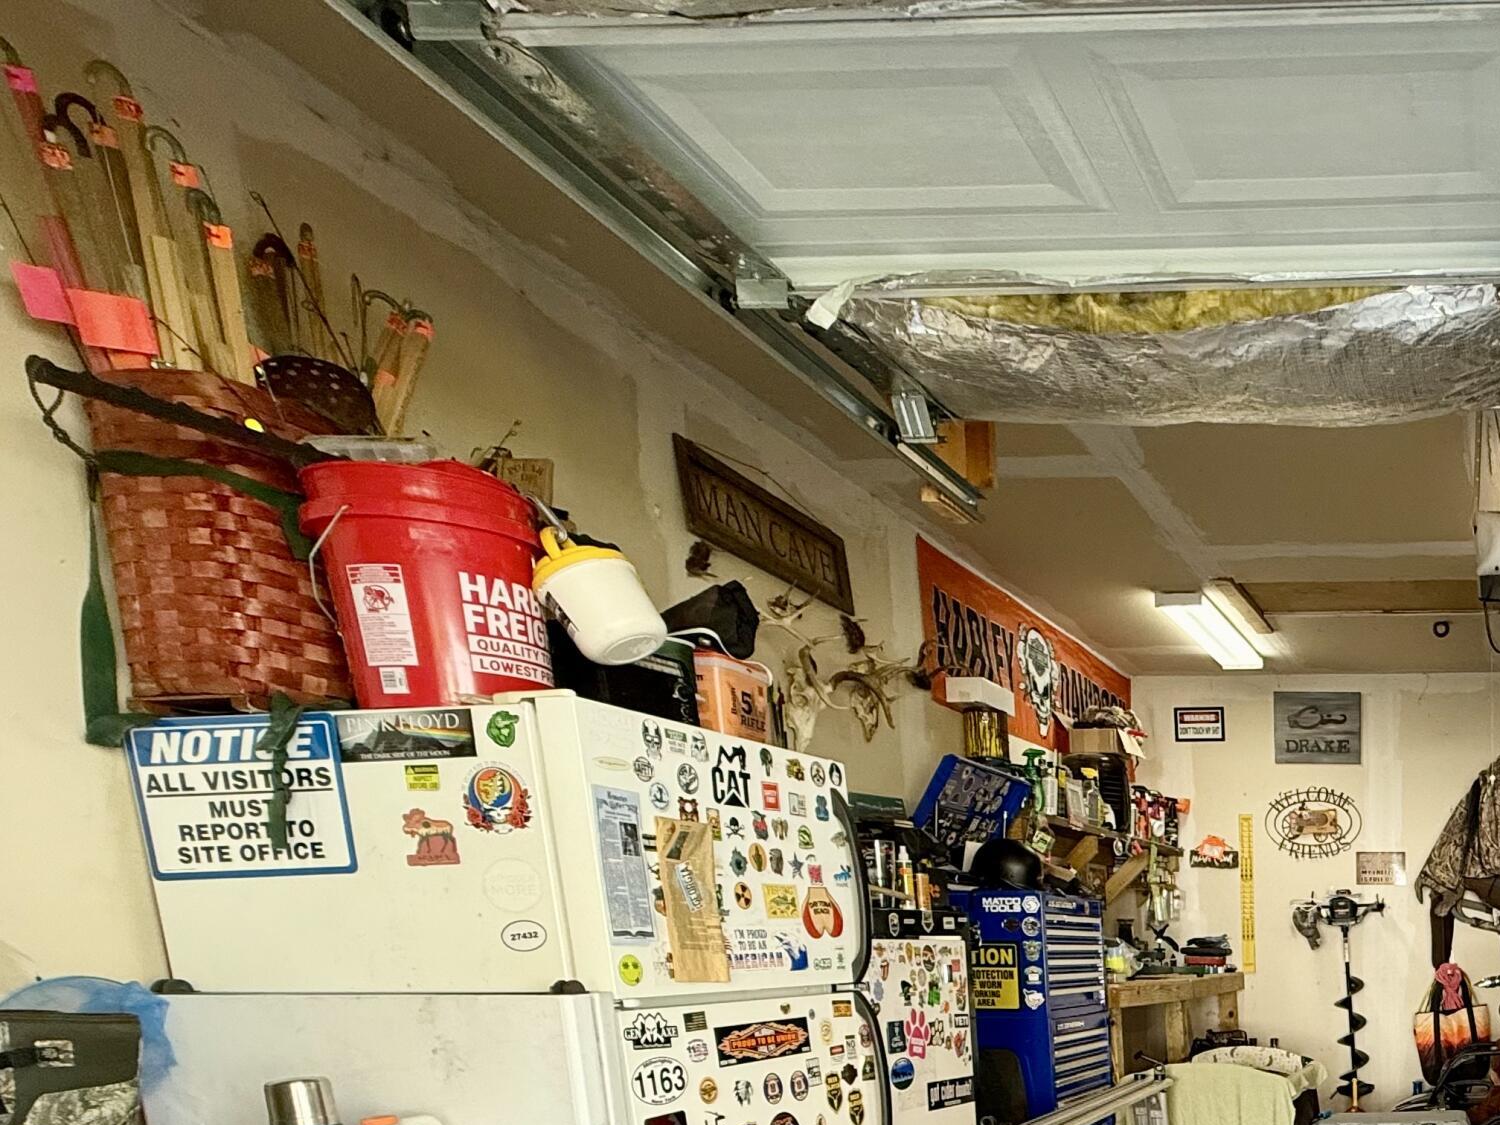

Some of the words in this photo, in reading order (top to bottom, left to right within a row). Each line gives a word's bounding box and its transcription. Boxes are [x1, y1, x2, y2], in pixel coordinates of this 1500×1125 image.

[695, 474, 763, 546] MAN
[768, 520, 835, 586] CAVE
[458, 571, 542, 620] HARB
[462, 603, 548, 649] FREIG
[933, 584, 1014, 692] HARLEY
[477, 639, 539, 662] QUALITY
[480, 658, 538, 679] LOWEST
[741, 691, 753, 715] 5
[345, 716, 395, 733] PINK
[401, 712, 461, 731] FLOYD
[741, 715, 766, 732] RIFLE
[150, 725, 314, 764] NOTIE
[1285, 738, 1350, 753] DRAKE
[146, 771, 195, 793] ALL
[206, 766, 332, 792] VISITORS
[711, 769, 751, 808] CAT
[209, 798, 272, 818] MUST
[1269, 786, 1355, 814] WELCOME
[178, 821, 272, 842] REPORT
[284, 819, 315, 837] TO
[177, 844, 231, 864] SITE
[238, 841, 327, 862] OFFICE
[1278, 838, 1350, 860] FRIENDS
[809, 900, 832, 910] DAYTONA
[982, 897, 1021, 905] MATCO
[510, 931, 539, 941] 27432
[734, 929, 745, 939] I'M
[746, 929, 768, 939] PROUD
[738, 941, 747, 950] TO
[747, 941, 757, 950] BE
[758, 940, 768, 950] AN
[727, 951, 784, 969] AMERICAN
[971, 948, 1013, 965] TION
[972, 969, 1014, 980] OTECTION
[980, 980, 1002, 989] WORN
[974, 990, 1000, 998] ORKING
[977, 998, 996, 1007] AREA
[955, 1016, 969, 1026] YETI
[662, 1026, 678, 1038] AXE
[732, 1038, 757, 1049] PROUD
[757, 1037, 766, 1045] TO
[634, 1065, 686, 1099] 1163
